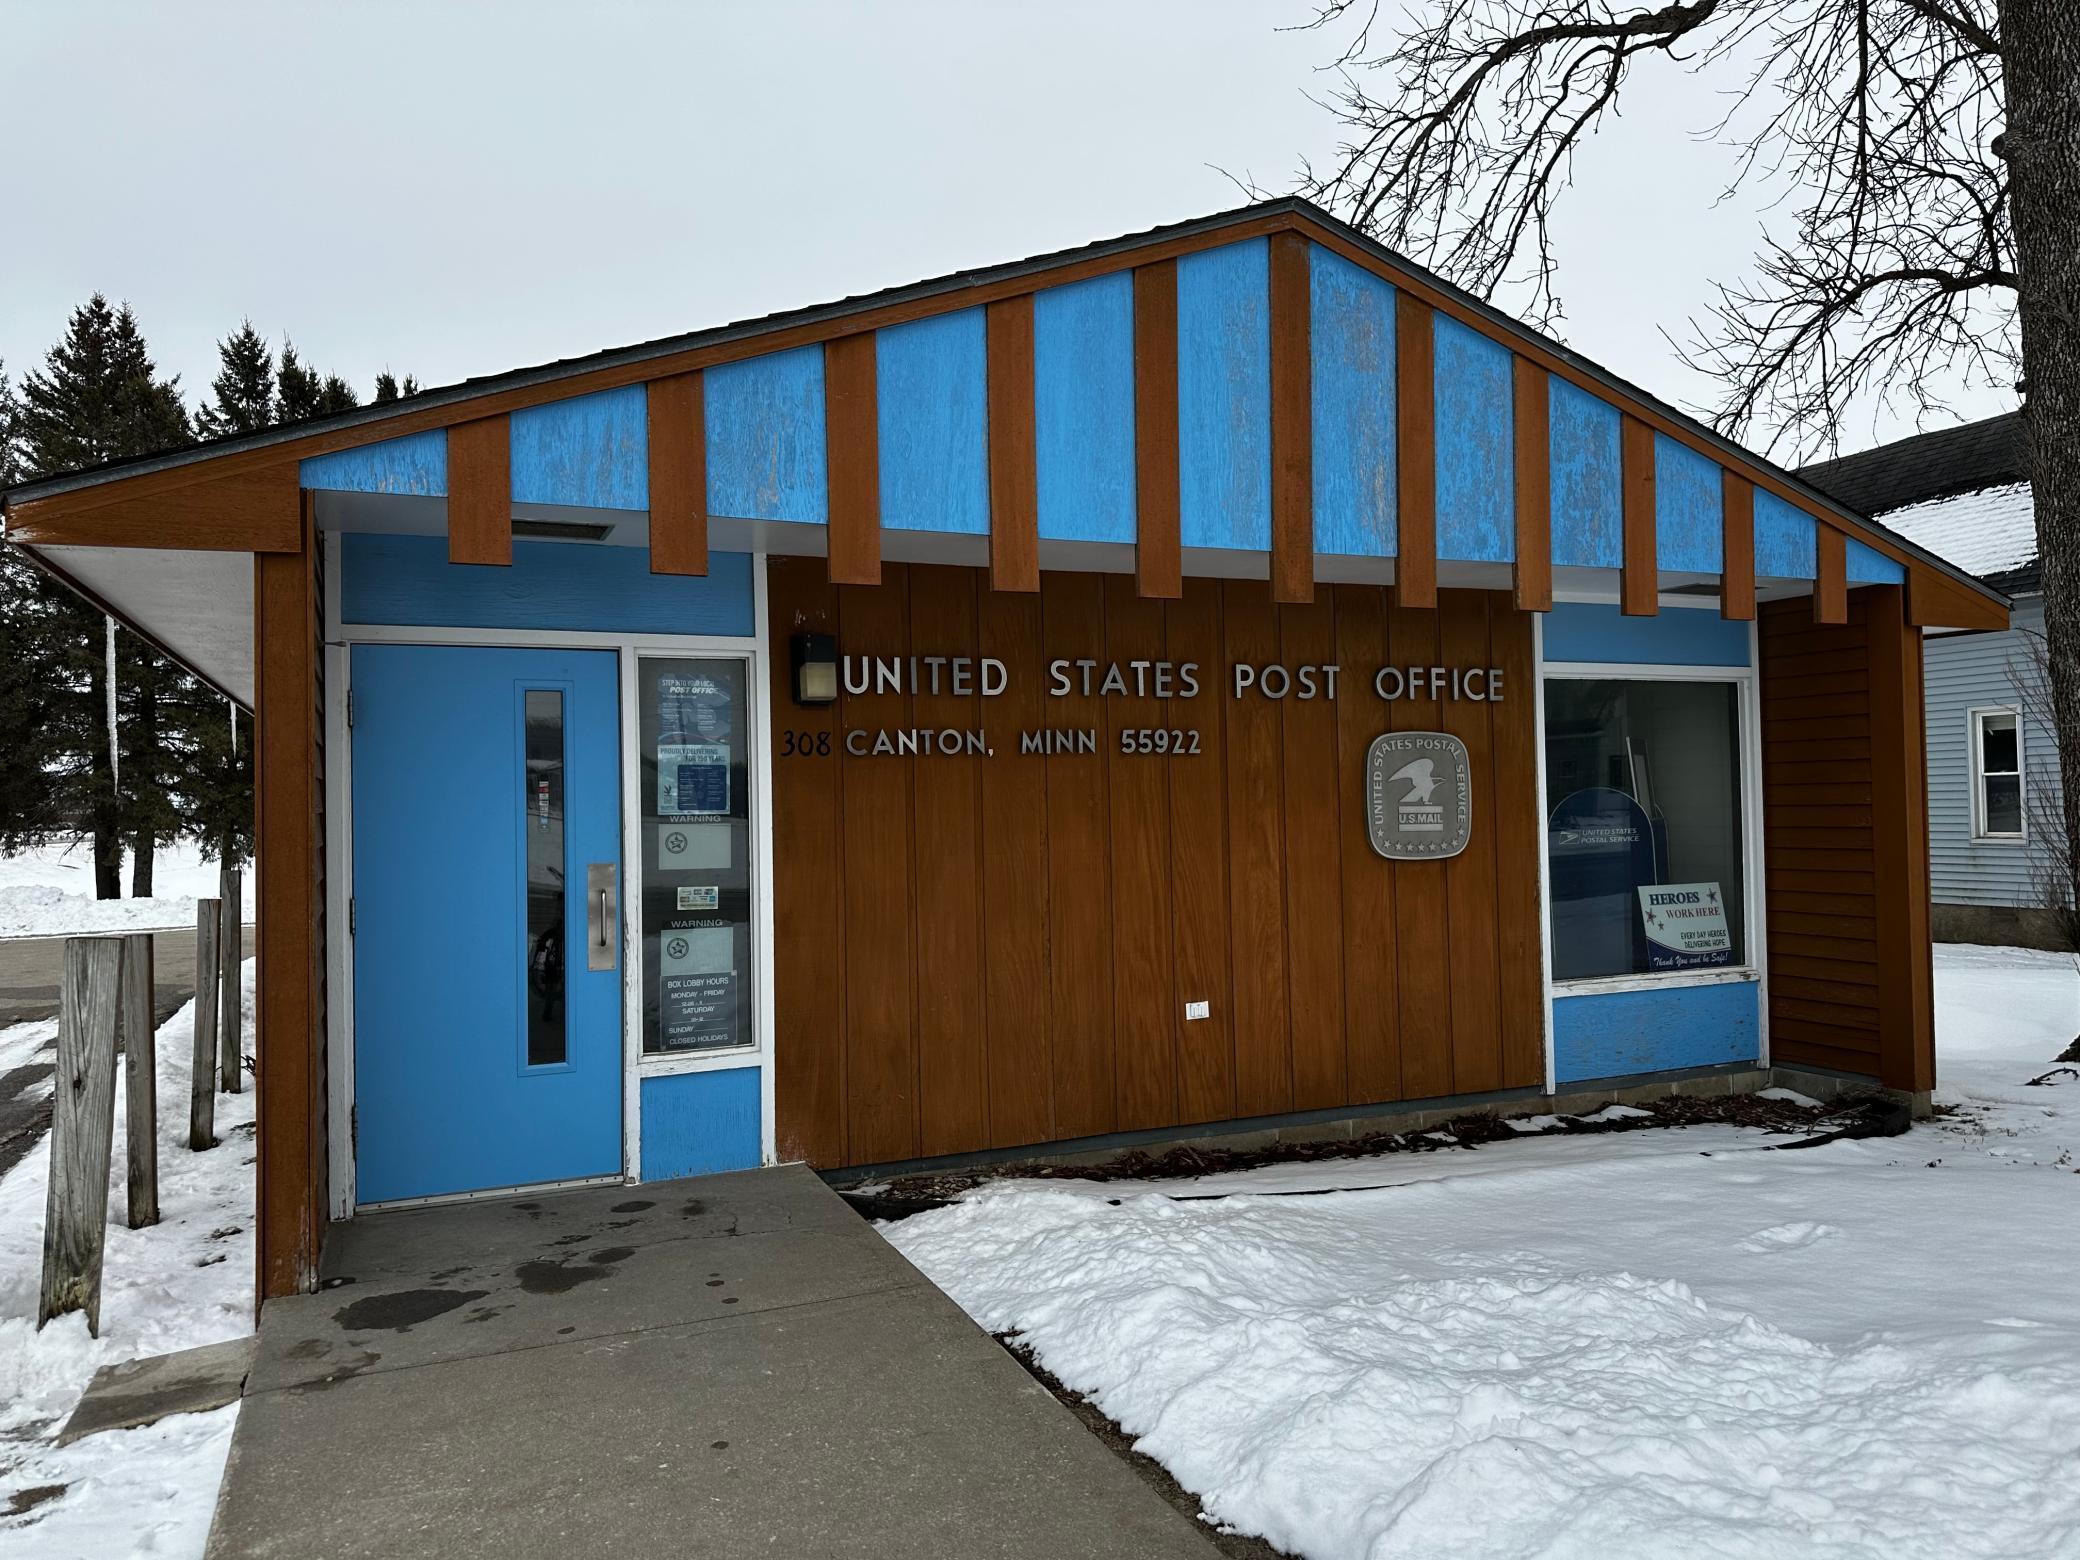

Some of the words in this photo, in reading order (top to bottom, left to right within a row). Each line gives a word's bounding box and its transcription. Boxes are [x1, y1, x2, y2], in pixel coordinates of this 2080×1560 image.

[843, 655, 1008, 696] UNITED
[1050, 659, 1199, 698] STATES
[1234, 664, 1341, 699] POST
[1375, 666, 1504, 701] OFFICE
[669, 686, 691, 694] POST
[781, 730, 832, 757] 308
[846, 728, 994, 758] CANTON,
[1021, 729, 1096, 754] MINN
[1121, 728, 1201, 754] 55922
[1374, 739, 1412, 767] STATES
[1416, 739, 1461, 760] POSTAL
[1373, 771, 1384, 825] UNITED
[1455, 764, 1467, 823] SERVICE
[669, 815, 721, 823] WARNING
[1582, 828, 1610, 836] UNITED
[1610, 827, 1637, 835] STATES
[1581, 836, 1608, 844] POSTAL
[1608, 834, 1640, 843] SERVICE
[1649, 891, 1700, 906] HEROES
[1665, 908, 1695, 919] WORK
[1695, 906, 1721, 917] HERE
[671, 918, 723, 928] WARNING
[1680, 931, 1696, 940] EVERY
[1696, 930, 1707, 939] DAY
[1707, 929, 1727, 938] HEROES
[1684, 940, 1711, 949] DELIVERING
[1712, 938, 1726, 947] HOPE
[1653, 956, 1674, 967] Thank
[1675, 955, 1688, 967] You
[1711, 952, 1729, 964] Safe!
[667, 980, 682, 989] BOX
[683, 978, 705, 988] LOBBY
[706, 976, 729, 986] HOURS
[671, 991, 698, 999] MONDAY
[703, 989, 726, 997] FRIDAY
[682, 1005, 715, 1014] SATURDAY
[668, 1025, 694, 1034] SUNDAY
[669, 1036, 697, 1045] CLOSED
[697, 1033, 729, 1042] HOLIDAYS
